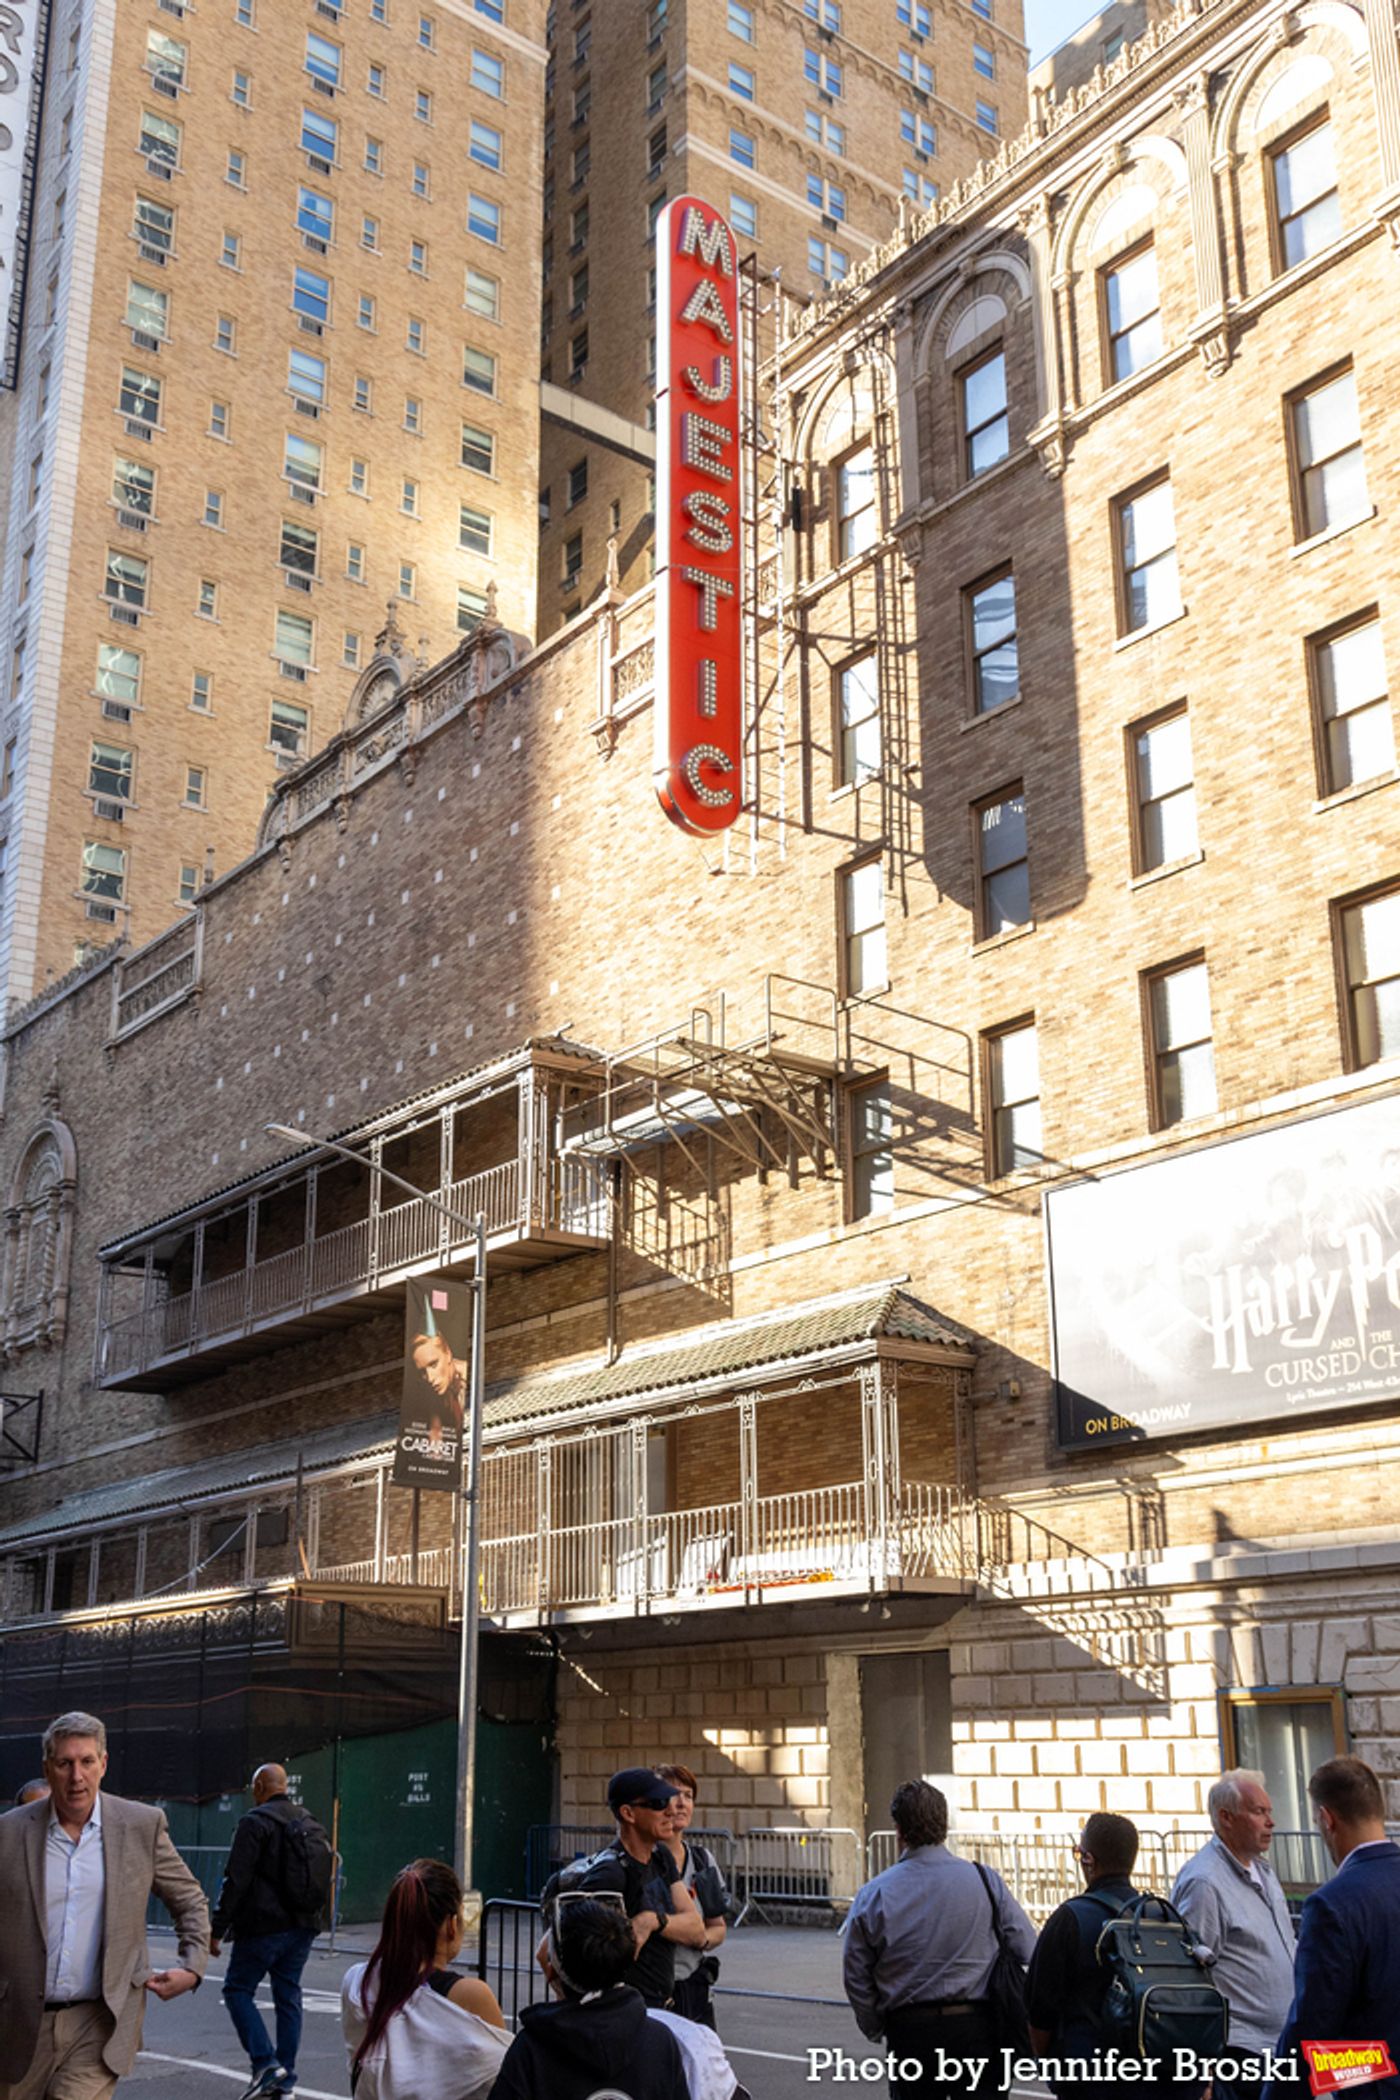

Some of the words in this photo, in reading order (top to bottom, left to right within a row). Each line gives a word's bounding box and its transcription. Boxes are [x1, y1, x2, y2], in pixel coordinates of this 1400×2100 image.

[678, 206, 735, 808] MAJESTIC
[1199, 1252, 1343, 1375] Harry
[1330, 1336, 1356, 1351] AND
[1369, 1330, 1393, 1344] THE
[1265, 1351, 1361, 1388] CURSED
[1084, 1417, 1108, 1436] ON
[1110, 1402, 1192, 1432] BROADWAY
[401, 1436, 459, 1459] CABARET
